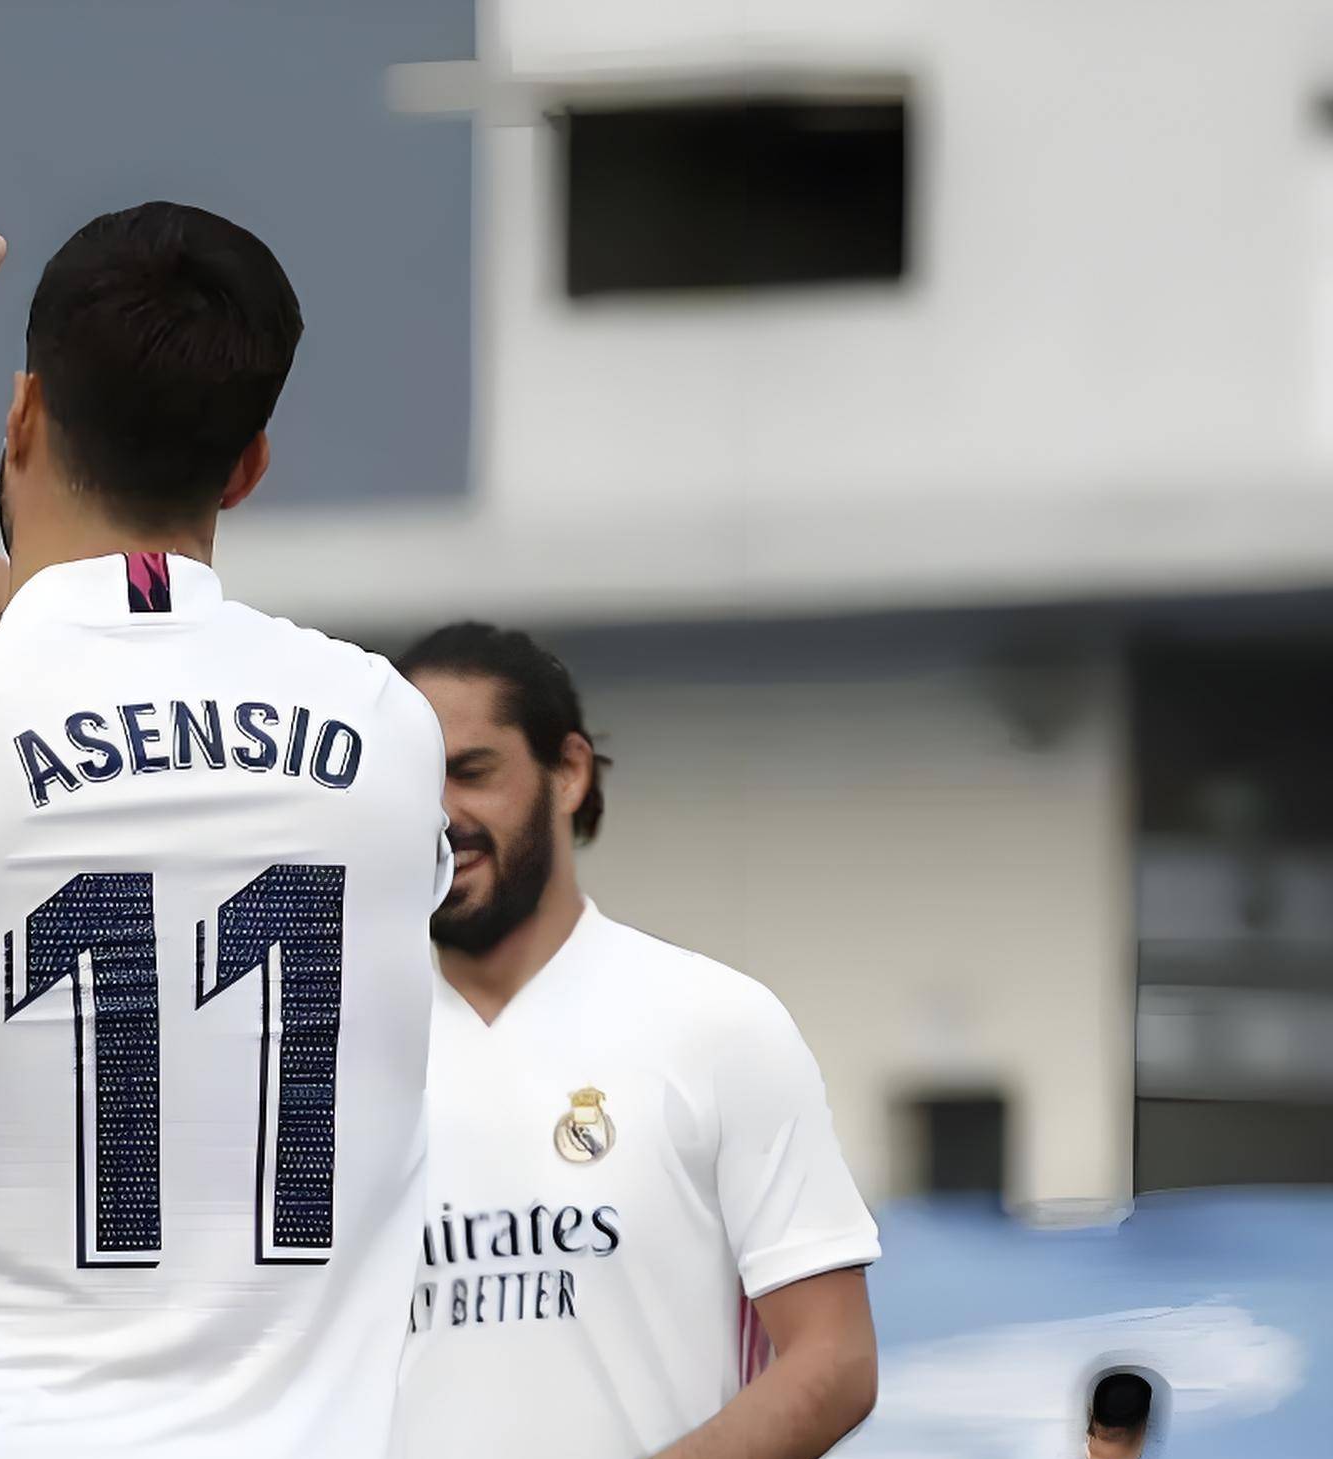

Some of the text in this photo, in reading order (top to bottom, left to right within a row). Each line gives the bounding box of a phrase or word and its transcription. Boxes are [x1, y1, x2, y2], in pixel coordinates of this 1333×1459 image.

[13, 699, 364, 808] ASENSIO
[4, 864, 347, 1269] 11
[451, 1269, 577, 1326] BETTER
